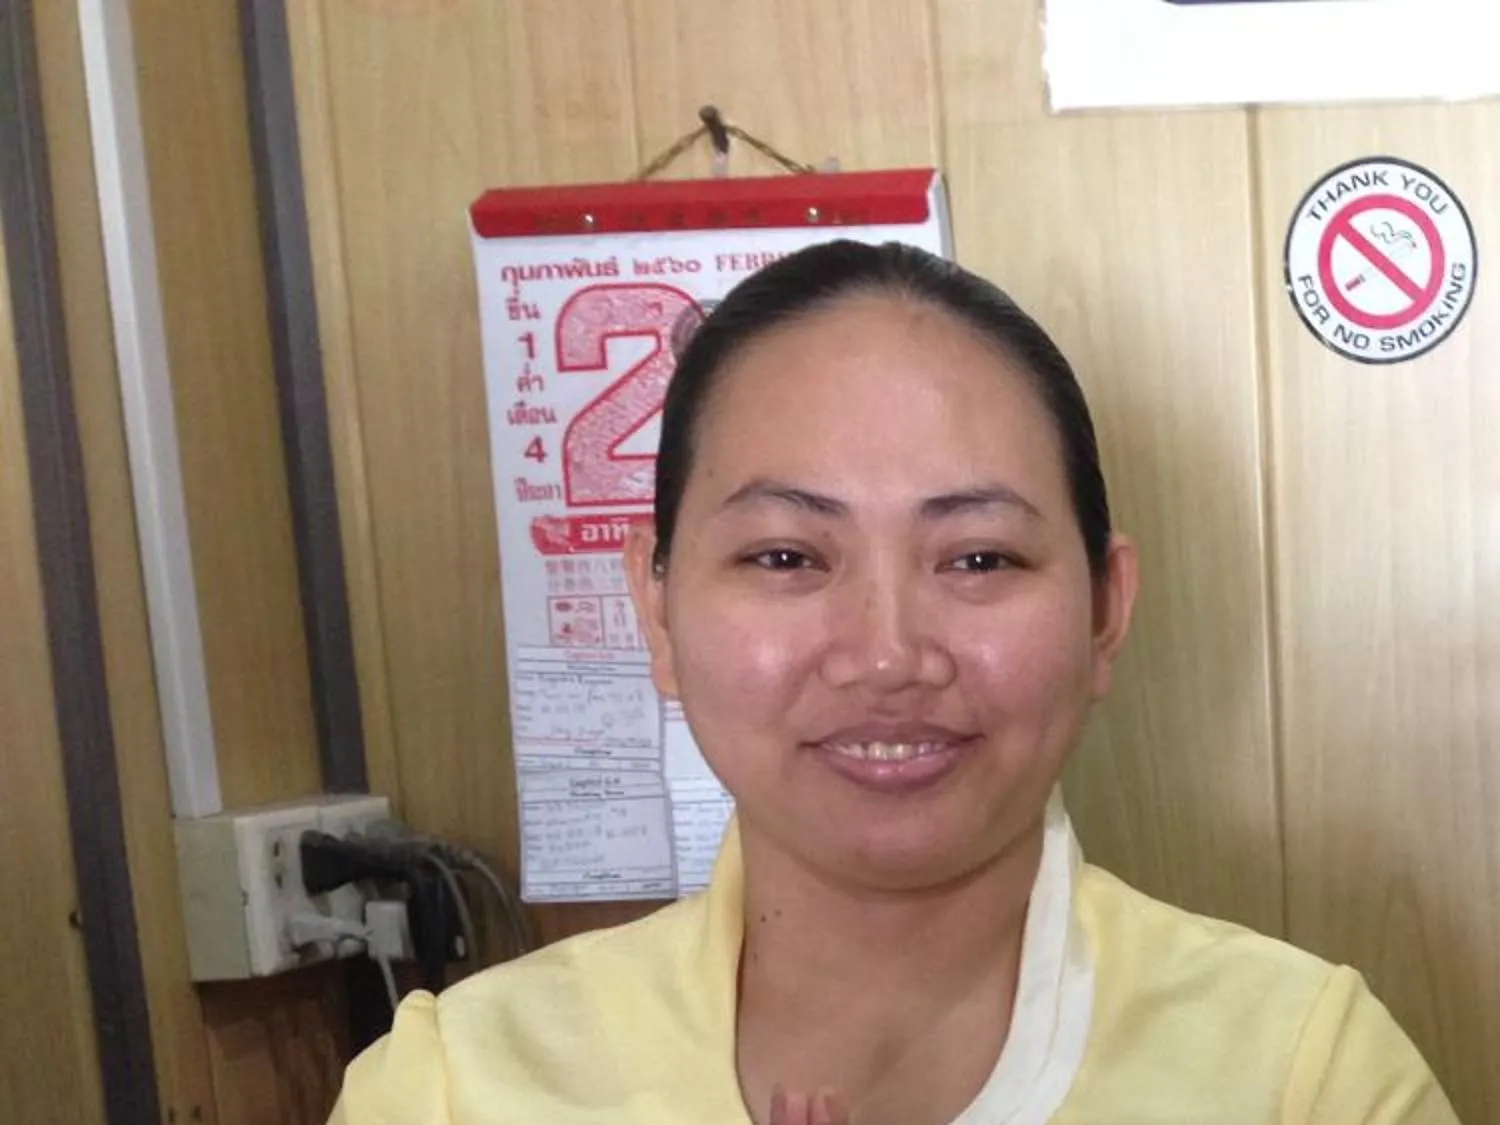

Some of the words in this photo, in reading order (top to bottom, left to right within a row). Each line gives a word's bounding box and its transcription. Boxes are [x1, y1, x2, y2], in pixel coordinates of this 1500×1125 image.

[1307, 170, 1389, 222] THANK
[1400, 174, 1448, 215] YOU
[1298, 274, 1331, 324] FOR
[1333, 323, 1371, 350] NO
[1380, 262, 1466, 352] SMOKING
[518, 332, 535, 359] 1
[555, 283, 704, 508] 2
[524, 435, 547, 463] 4
